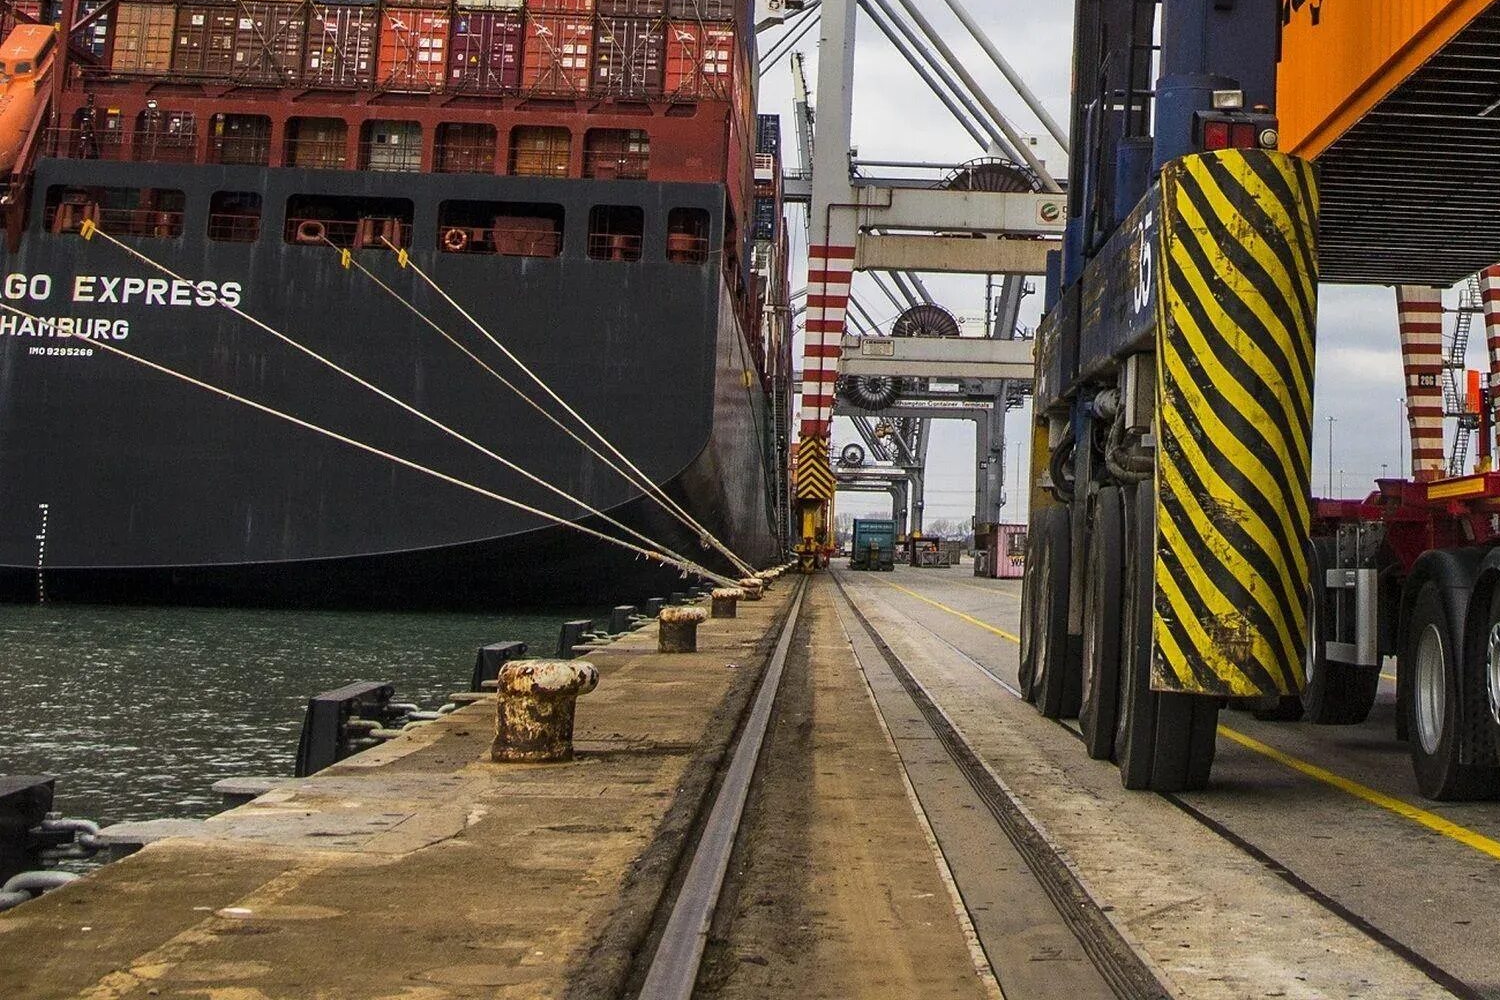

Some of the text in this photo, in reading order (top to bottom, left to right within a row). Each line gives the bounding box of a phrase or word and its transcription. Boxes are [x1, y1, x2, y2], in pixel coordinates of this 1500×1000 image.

[0, 273, 242, 308] GO EXPRESS
[0, 314, 130, 340] HAMBURG
